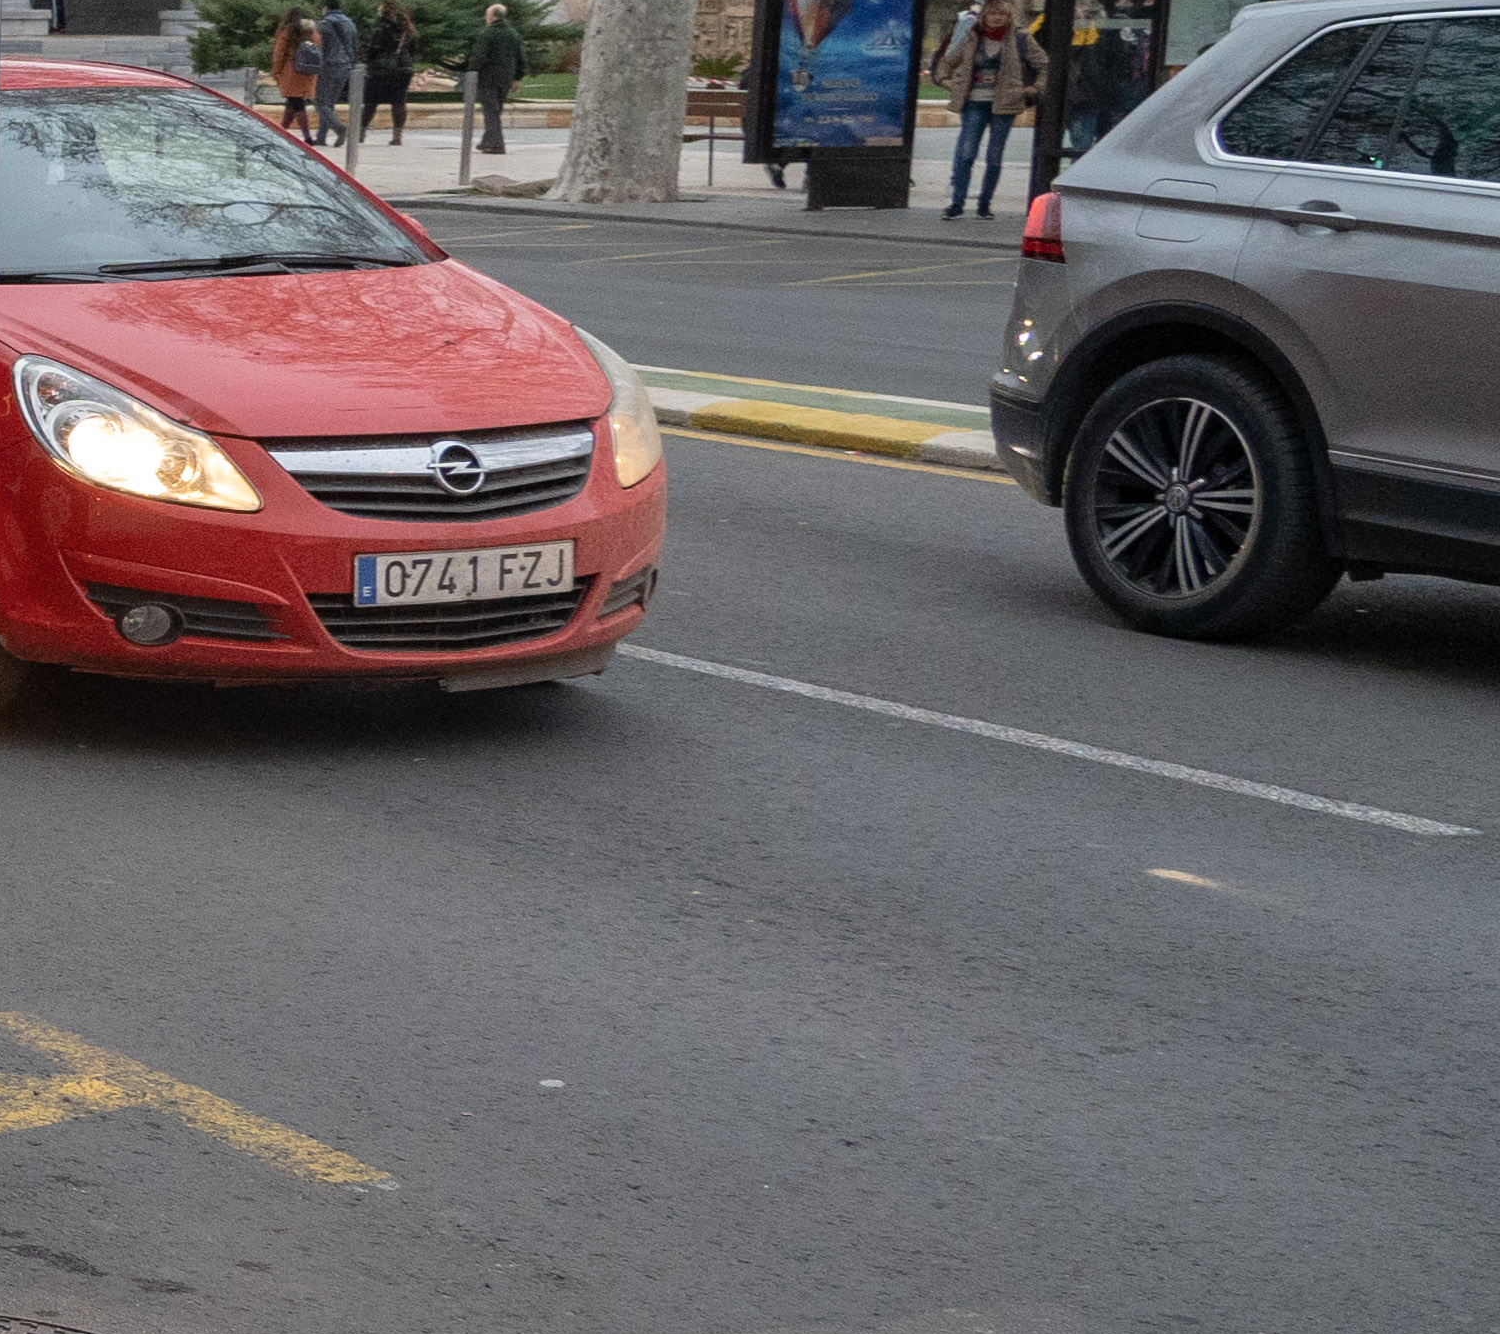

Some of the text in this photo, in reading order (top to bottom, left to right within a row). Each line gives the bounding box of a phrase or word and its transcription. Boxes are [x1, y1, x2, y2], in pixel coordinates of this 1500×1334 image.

[362, 548, 564, 598] E 0741 FZJ
